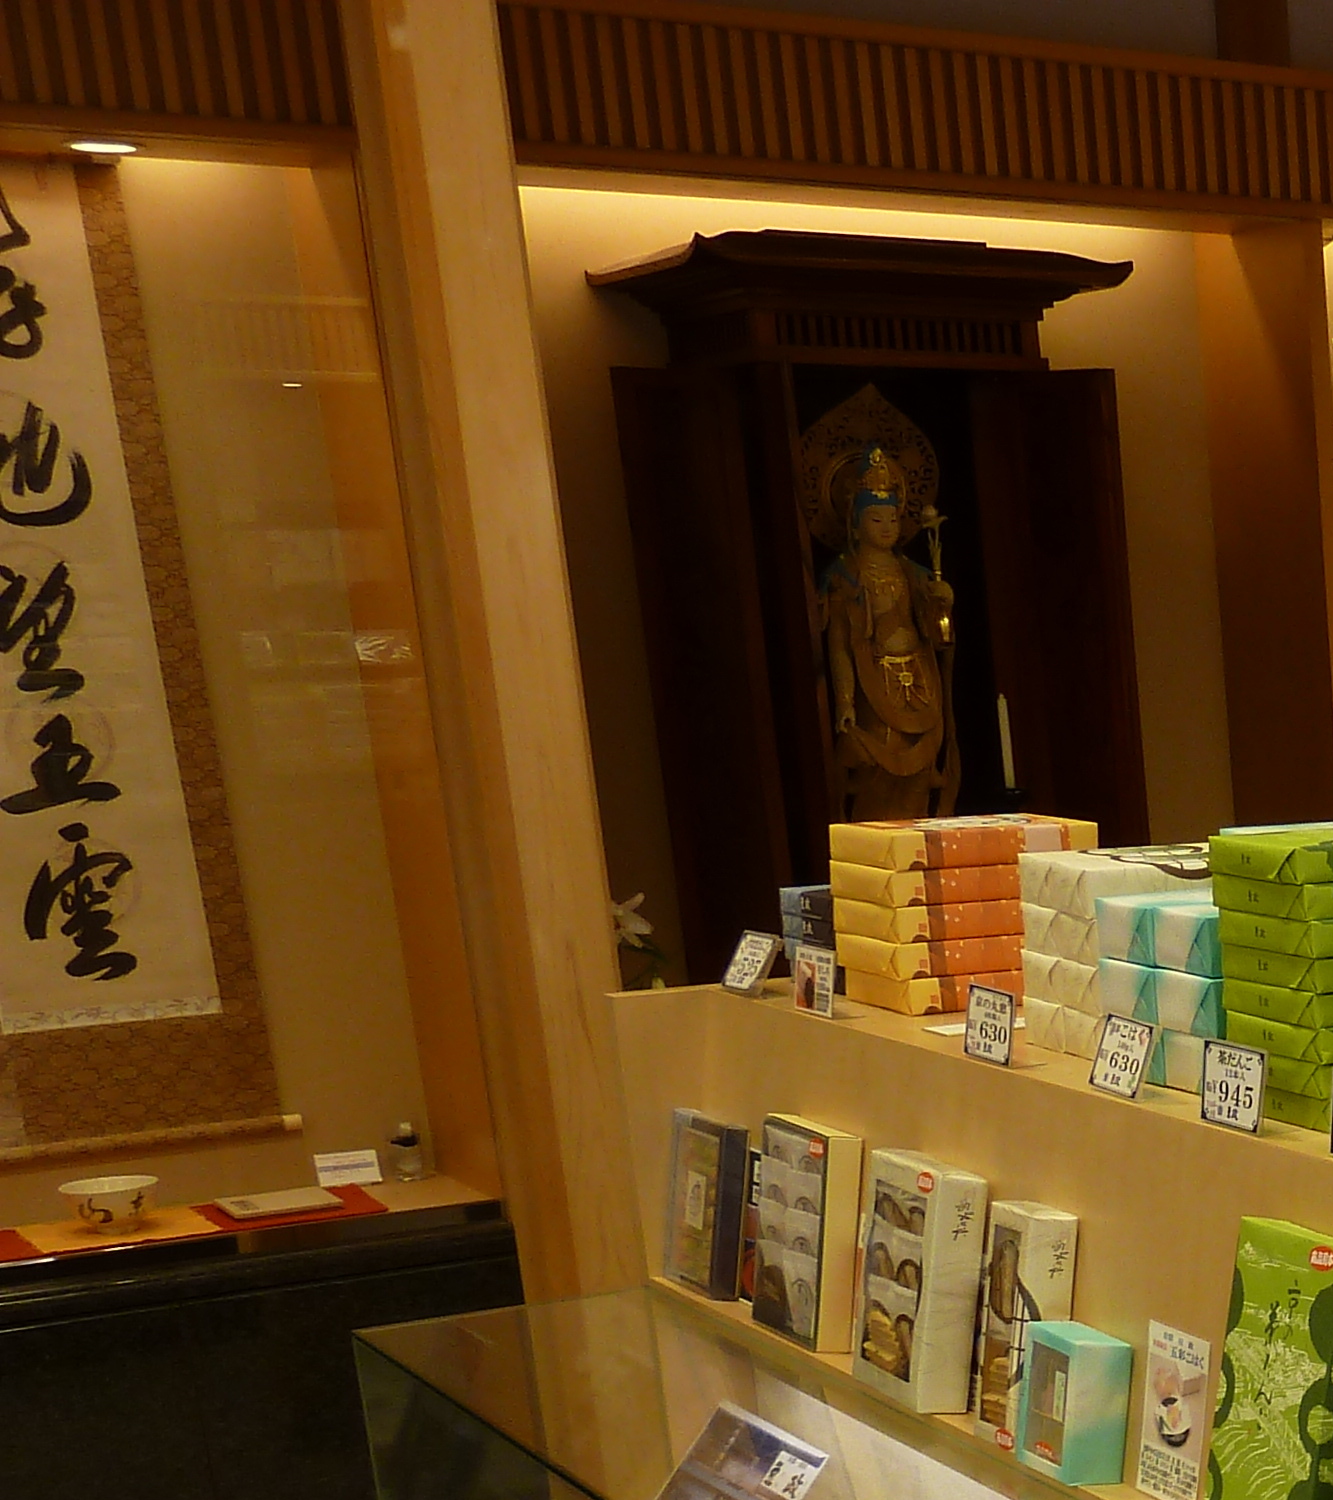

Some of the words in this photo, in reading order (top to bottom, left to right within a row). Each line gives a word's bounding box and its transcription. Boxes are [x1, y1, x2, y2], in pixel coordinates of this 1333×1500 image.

[980, 1021, 1007, 1044] 630
[1109, 1051, 1140, 1075] 630
[1218, 1050, 1253, 1072] 茶だんご
[1218, 1080, 1253, 1110] 945
[1171, 1347, 1204, 1369] 五彩こはく
